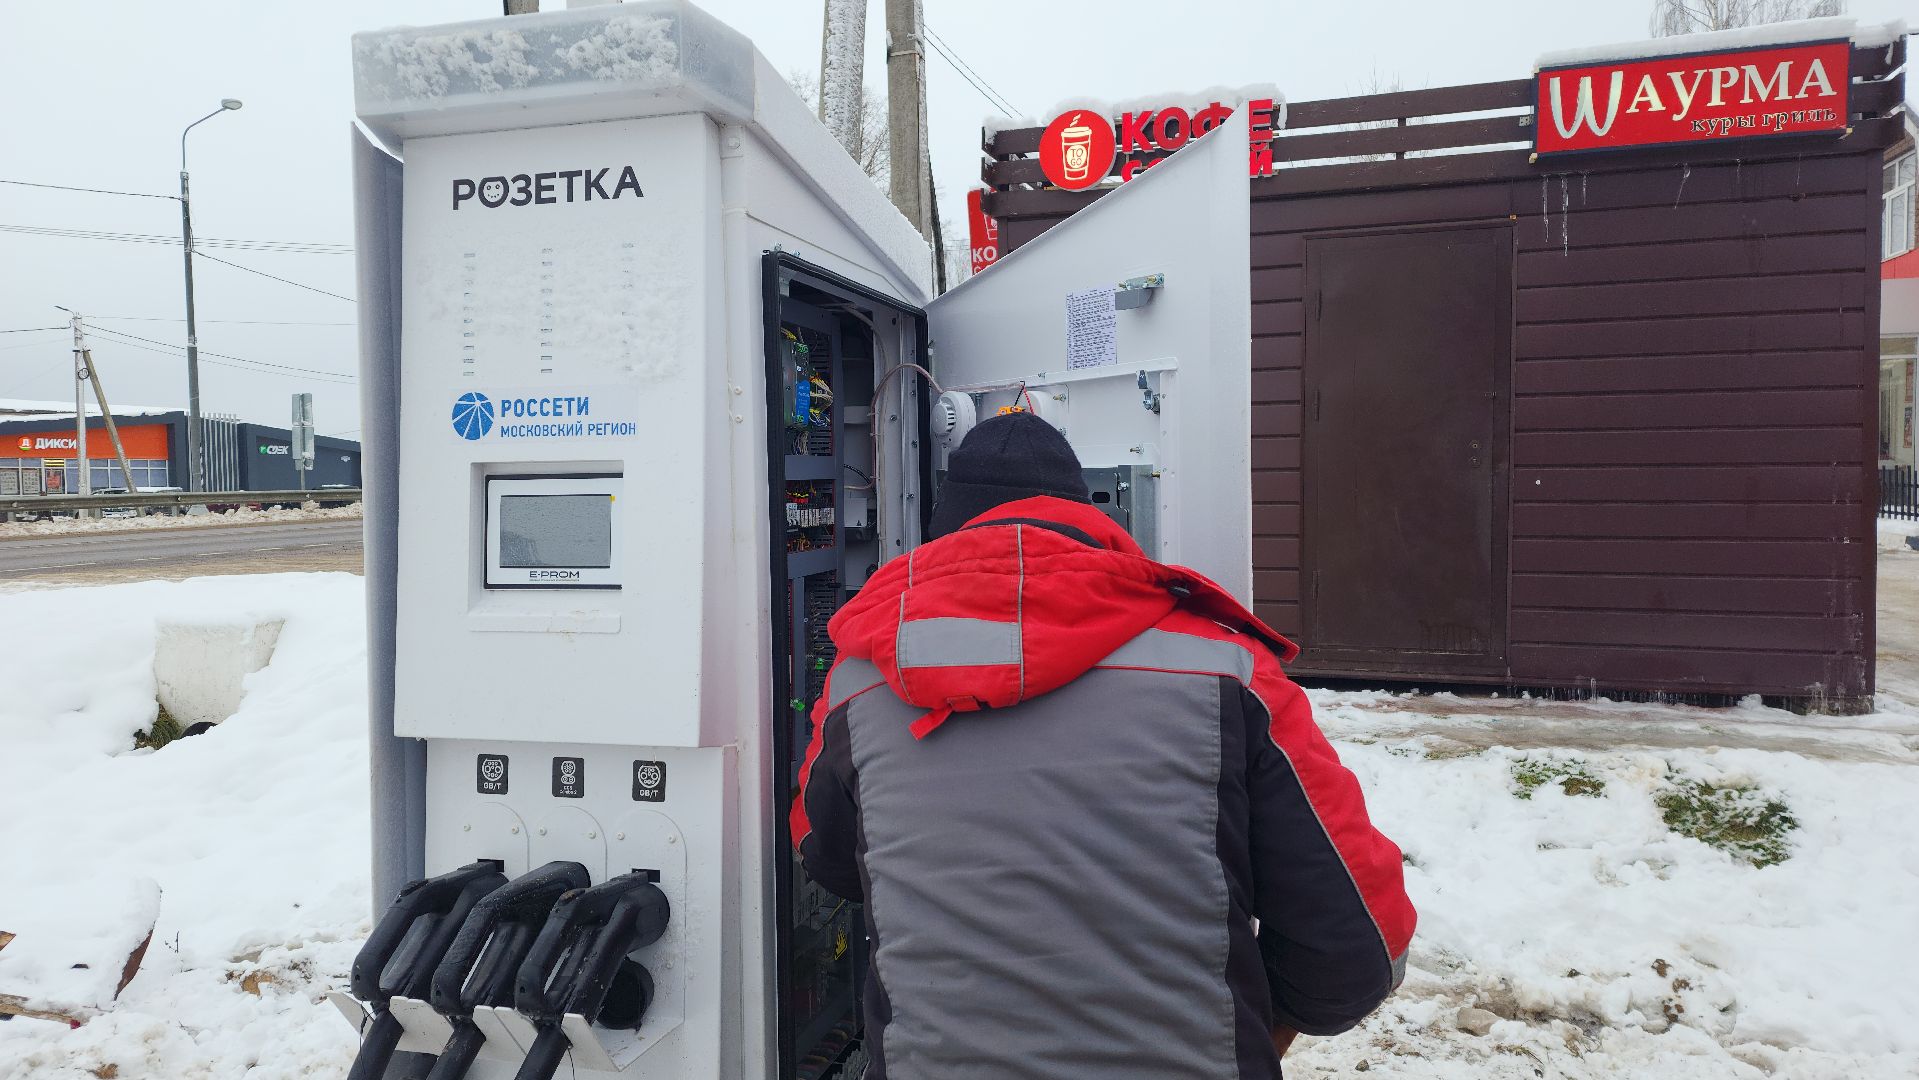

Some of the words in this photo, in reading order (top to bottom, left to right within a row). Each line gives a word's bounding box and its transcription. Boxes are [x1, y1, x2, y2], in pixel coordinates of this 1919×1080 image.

[1691, 114, 1755, 136] куры
[1762, 108, 1837, 131] гриль
[1070, 147, 1084, 158] TO
[1070, 157, 1082, 166] GO
[453, 165, 644, 211] РОЗЕТКА
[972, 245, 997, 263] КО
[501, 396, 589, 418] РОССЕТИ
[500, 421, 583, 438] МОСКОВСКИЙ
[587, 422, 636, 436] РЕГИОН
[34, 437, 77, 450] ДИКСИ
[529, 570, 580, 579] E-PROM
[483, 782, 502, 791] GB/T
[639, 789, 659, 799] GB/T
